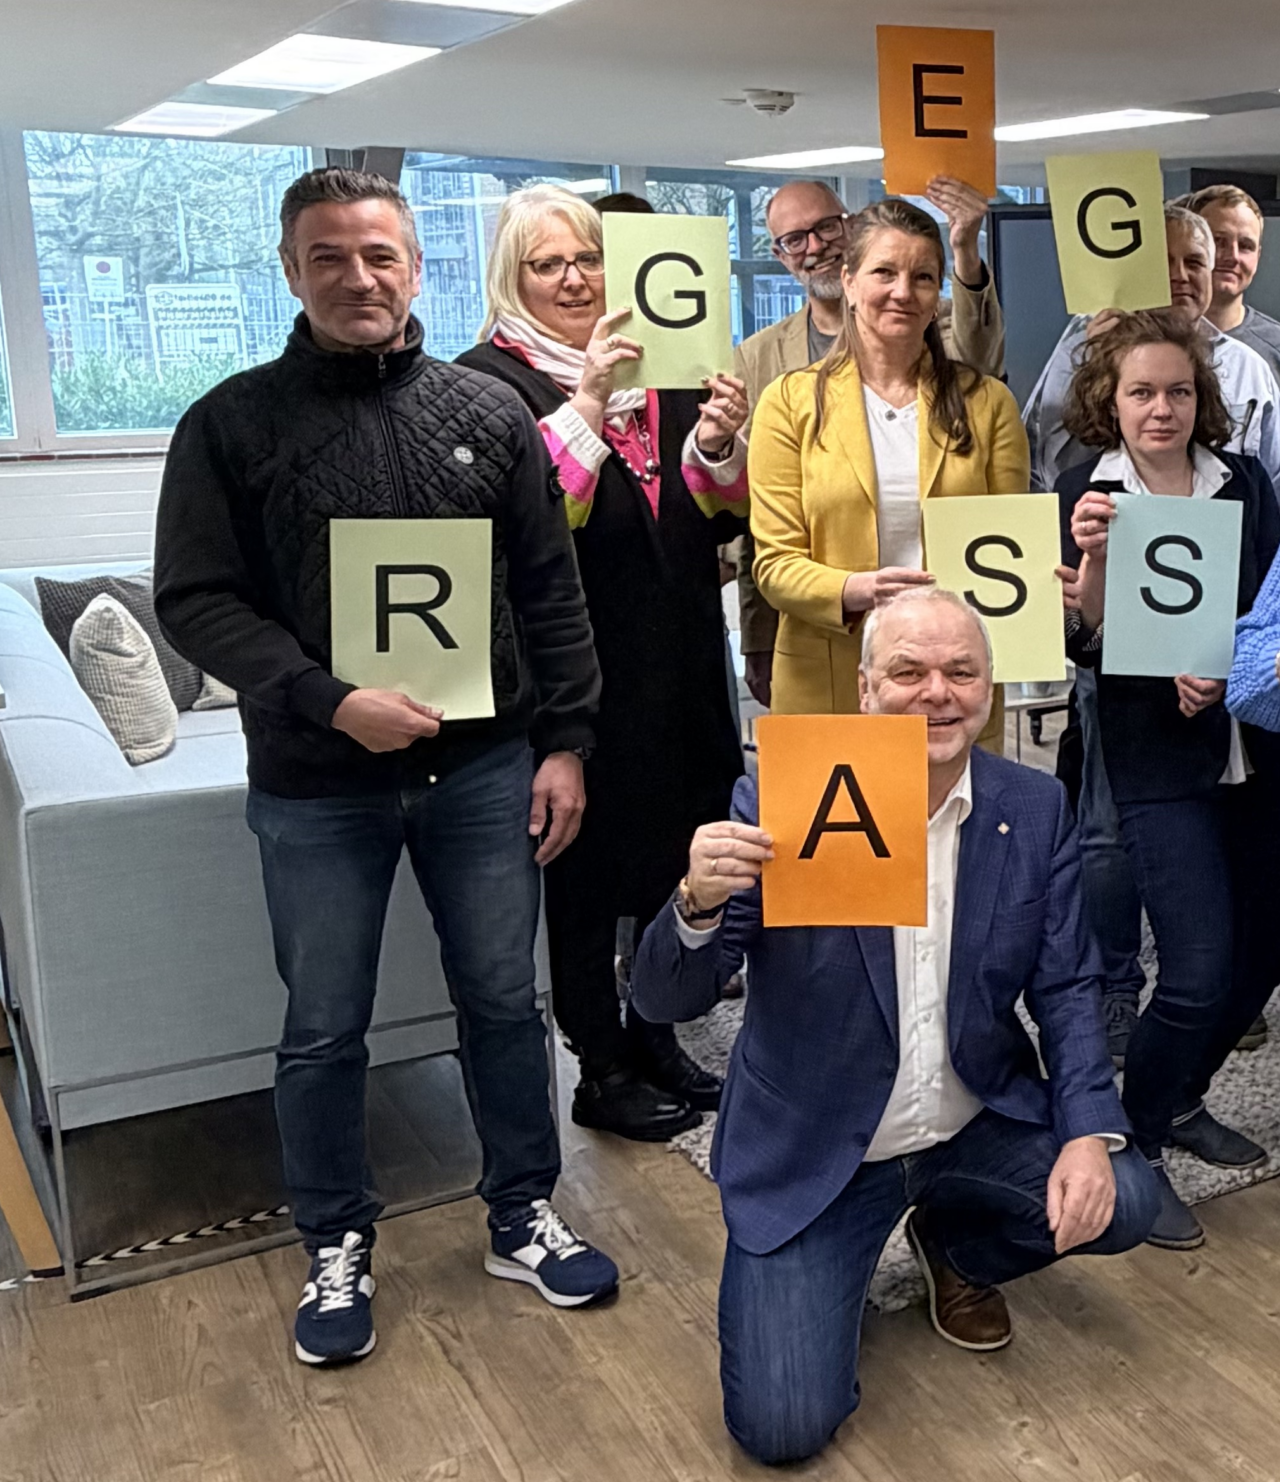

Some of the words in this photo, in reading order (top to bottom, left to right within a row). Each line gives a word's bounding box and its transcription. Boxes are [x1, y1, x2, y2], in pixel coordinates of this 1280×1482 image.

[912, 63, 968, 139] E
[1076, 187, 1143, 259] G
[634, 251, 707, 330] G
[375, 564, 460, 653] R
[963, 534, 1028, 618] S
[1139, 534, 1204, 616] S
[797, 763, 892, 860] A
